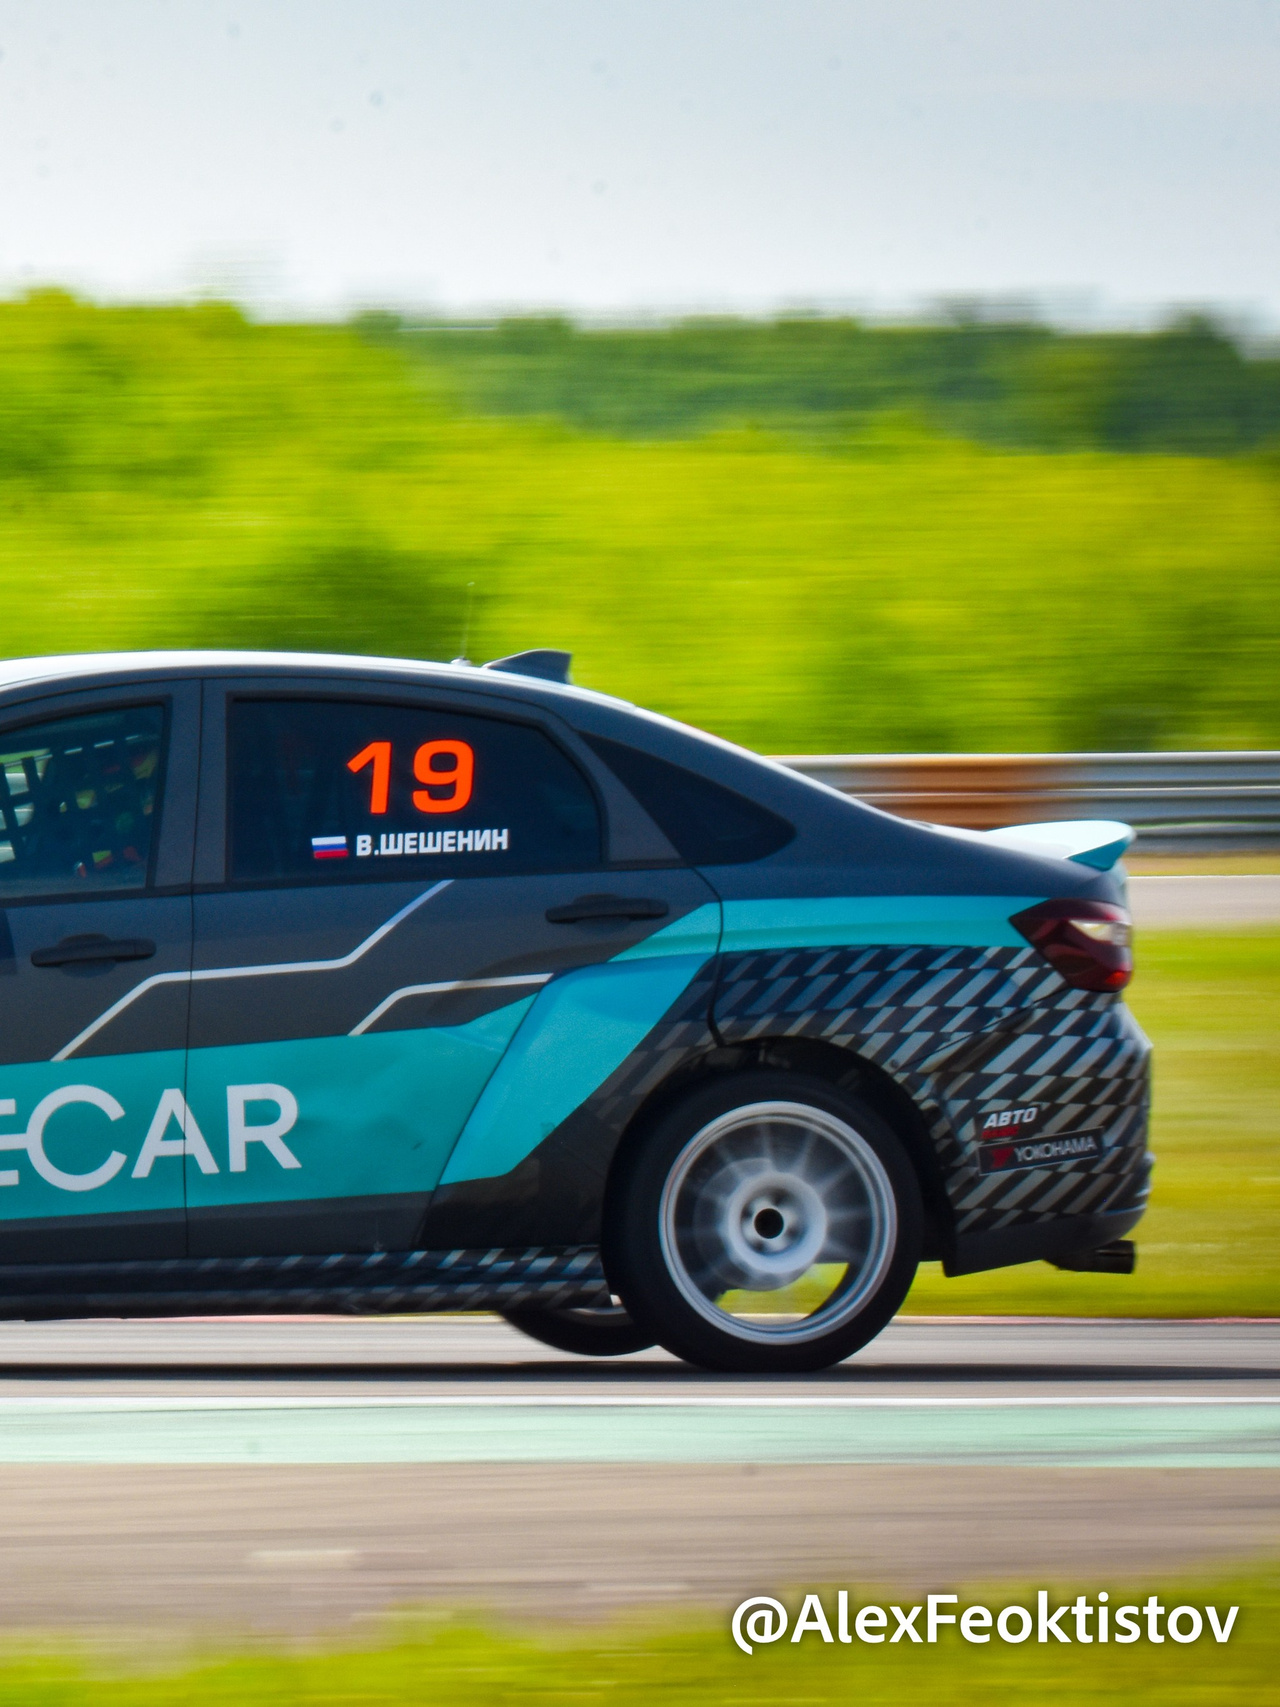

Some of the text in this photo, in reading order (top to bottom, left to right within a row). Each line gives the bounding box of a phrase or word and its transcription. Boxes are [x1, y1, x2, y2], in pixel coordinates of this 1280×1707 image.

[346, 739, 475, 814] 19
[355, 828, 509, 857] В.ШЕШЕНИН
[983, 1106, 1038, 1129] АВТО
[1013, 1135, 1098, 1162] YOKOHAMA
